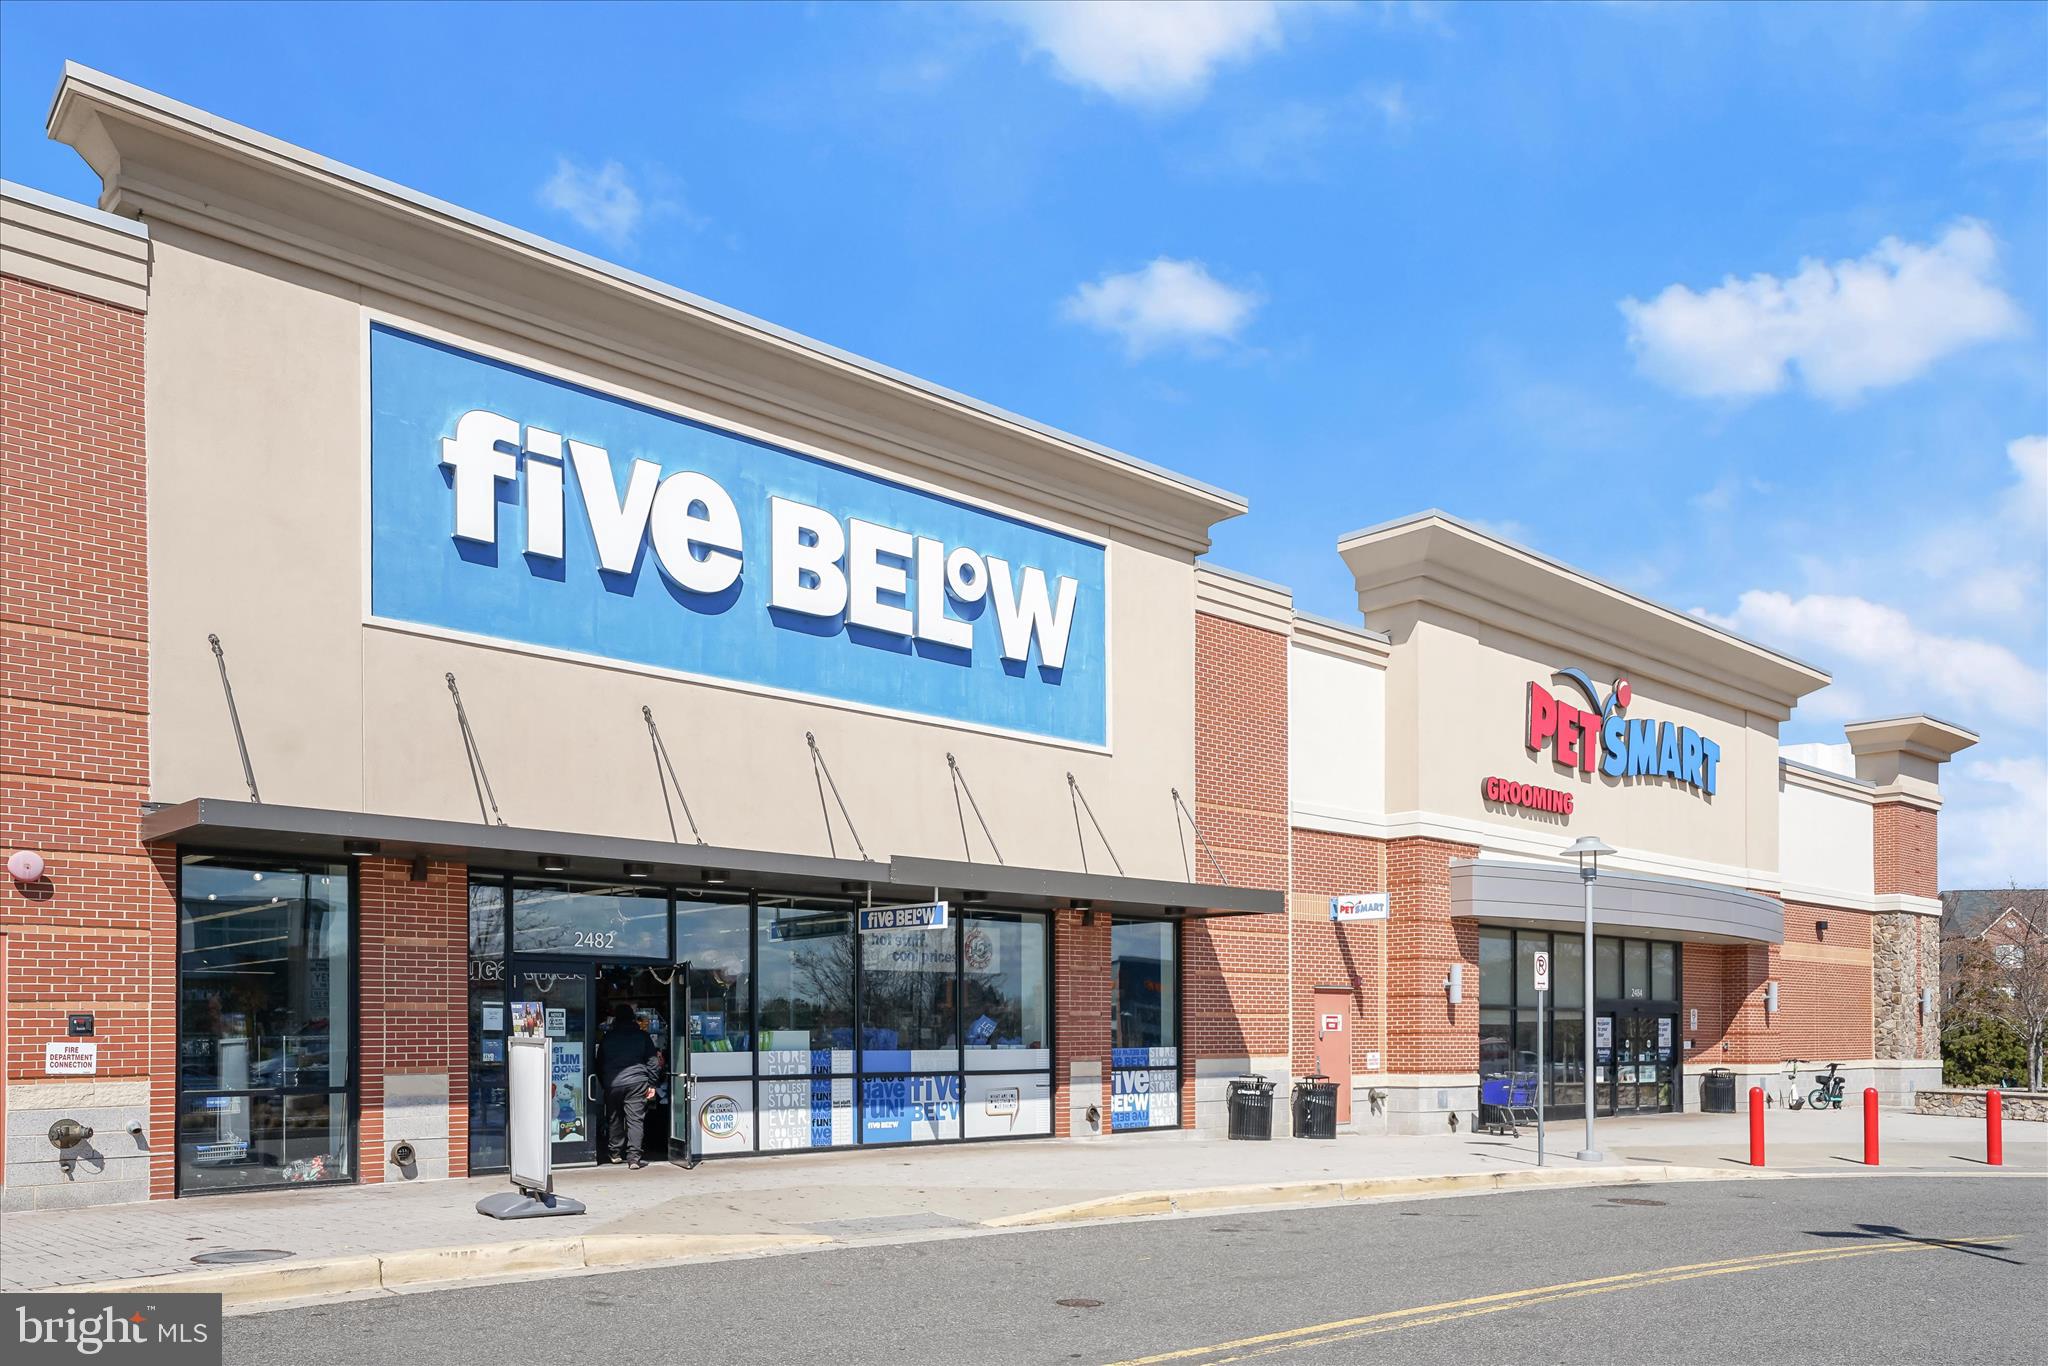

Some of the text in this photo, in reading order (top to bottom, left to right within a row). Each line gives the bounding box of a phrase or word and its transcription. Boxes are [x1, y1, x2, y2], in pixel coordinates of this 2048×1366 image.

[441, 409, 1079, 671] five BELOW
[1526, 680, 1721, 796] PETSMART
[1482, 775, 1574, 816] GROOMING
[1339, 902, 1385, 915] PETSMART
[867, 907, 936, 928] five BELOW
[574, 931, 614, 949] 2482
[768, 1051, 806, 1064] STORE
[768, 1083, 808, 1093] COOLEST
[1149, 1081, 1175, 1093] STORE
[768, 1093, 806, 1108] STORE
[769, 1109, 809, 1126] EVER
[768, 1127, 807, 1138] COOLEST
